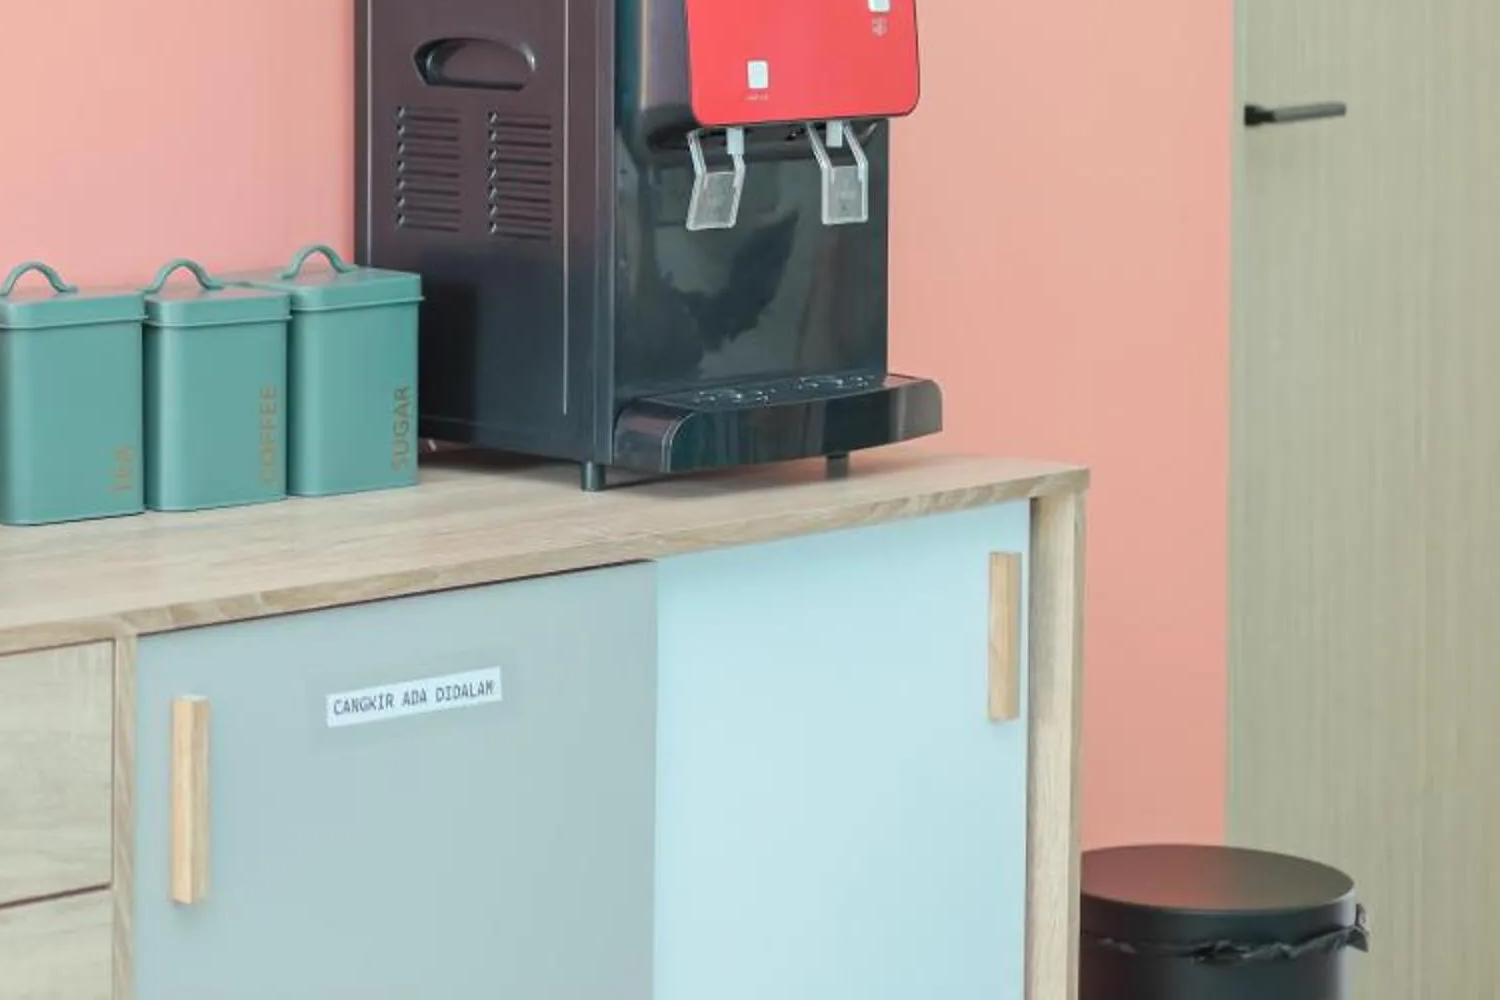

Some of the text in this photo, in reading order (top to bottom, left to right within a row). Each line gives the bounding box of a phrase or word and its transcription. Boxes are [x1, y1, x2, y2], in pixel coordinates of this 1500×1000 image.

[257, 383, 279, 487] COFFEE
[391, 384, 412, 473] SUGAR
[333, 679, 495, 716] CANGKIR ADA DIDALAM
